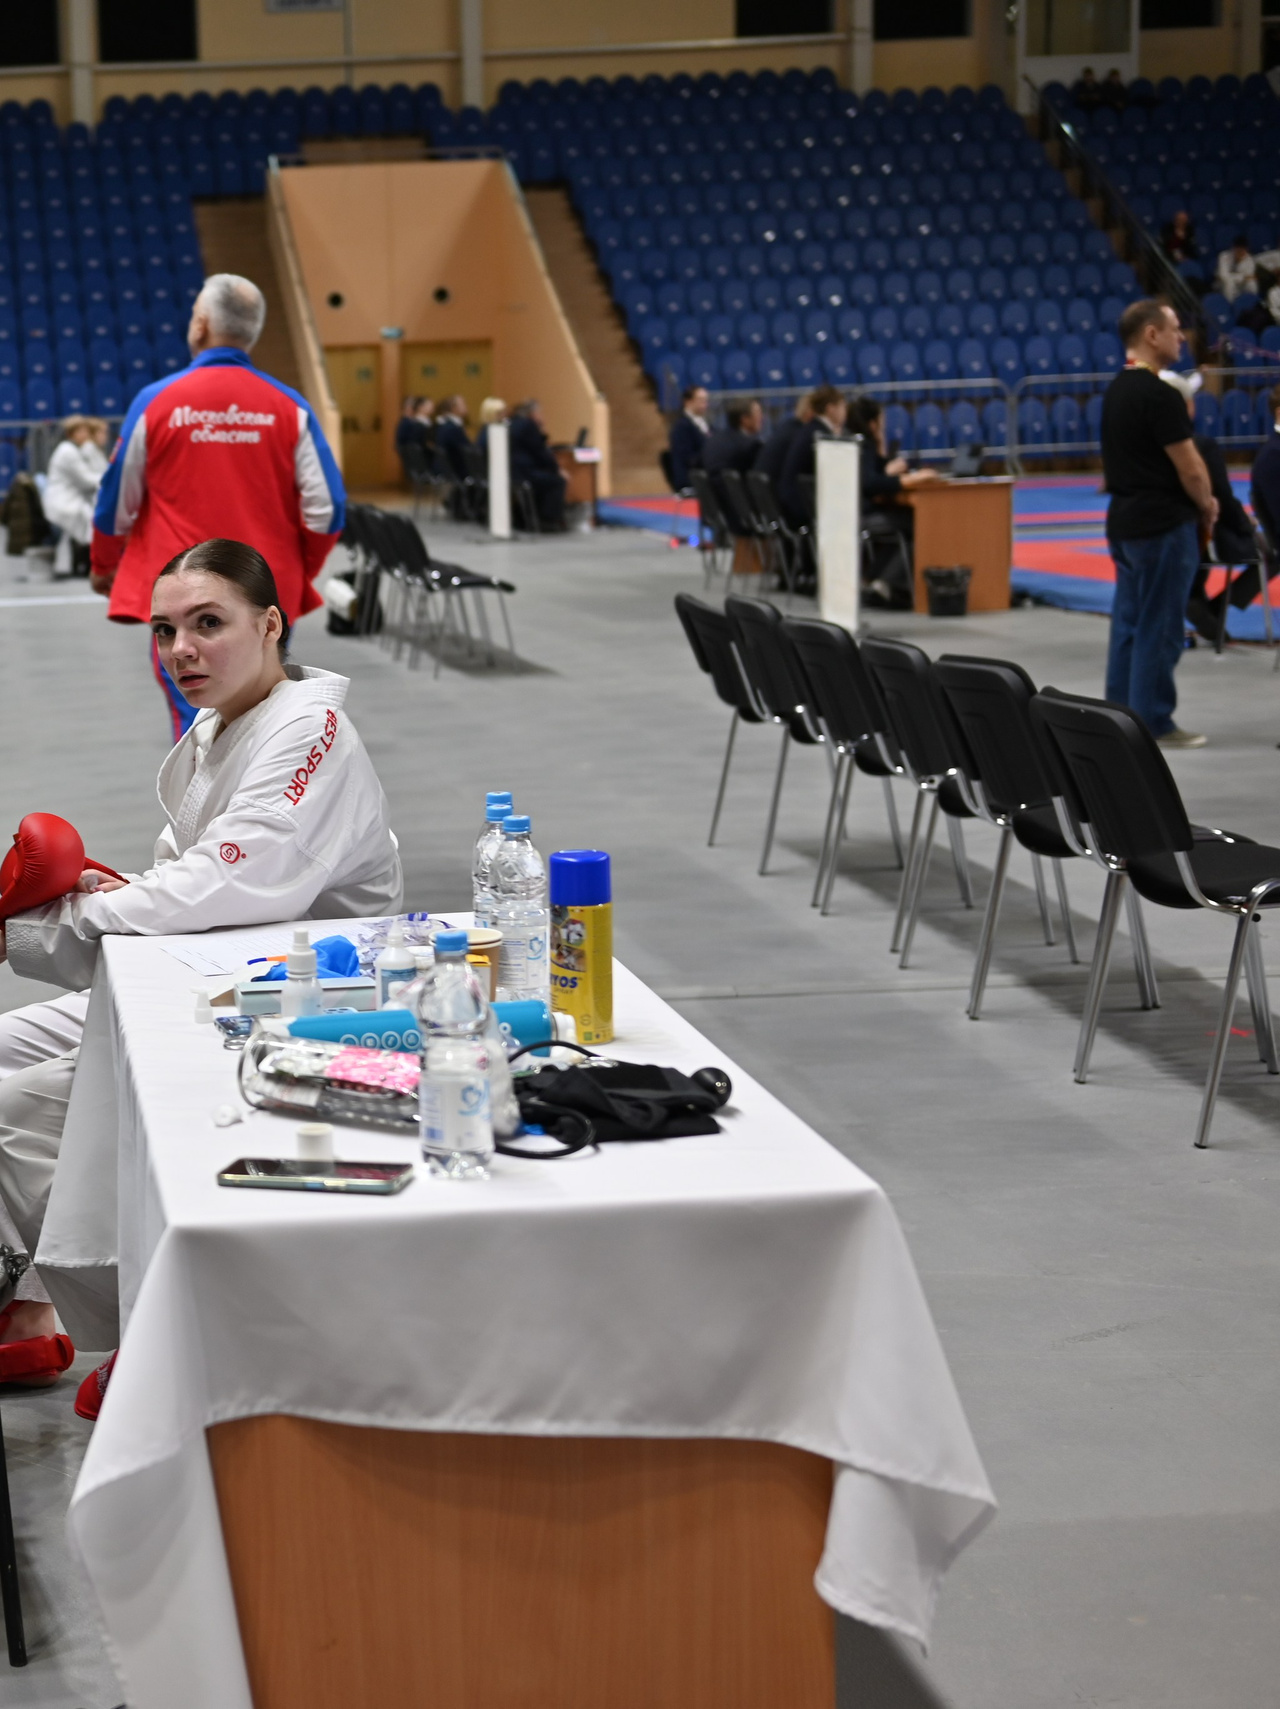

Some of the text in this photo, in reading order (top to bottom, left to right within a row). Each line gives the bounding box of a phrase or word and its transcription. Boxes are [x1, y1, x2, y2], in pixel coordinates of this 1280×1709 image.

[168, 403, 276, 429] Московская
[190, 423, 261, 444] область
[283, 708, 338, 806] BEST SPORT
